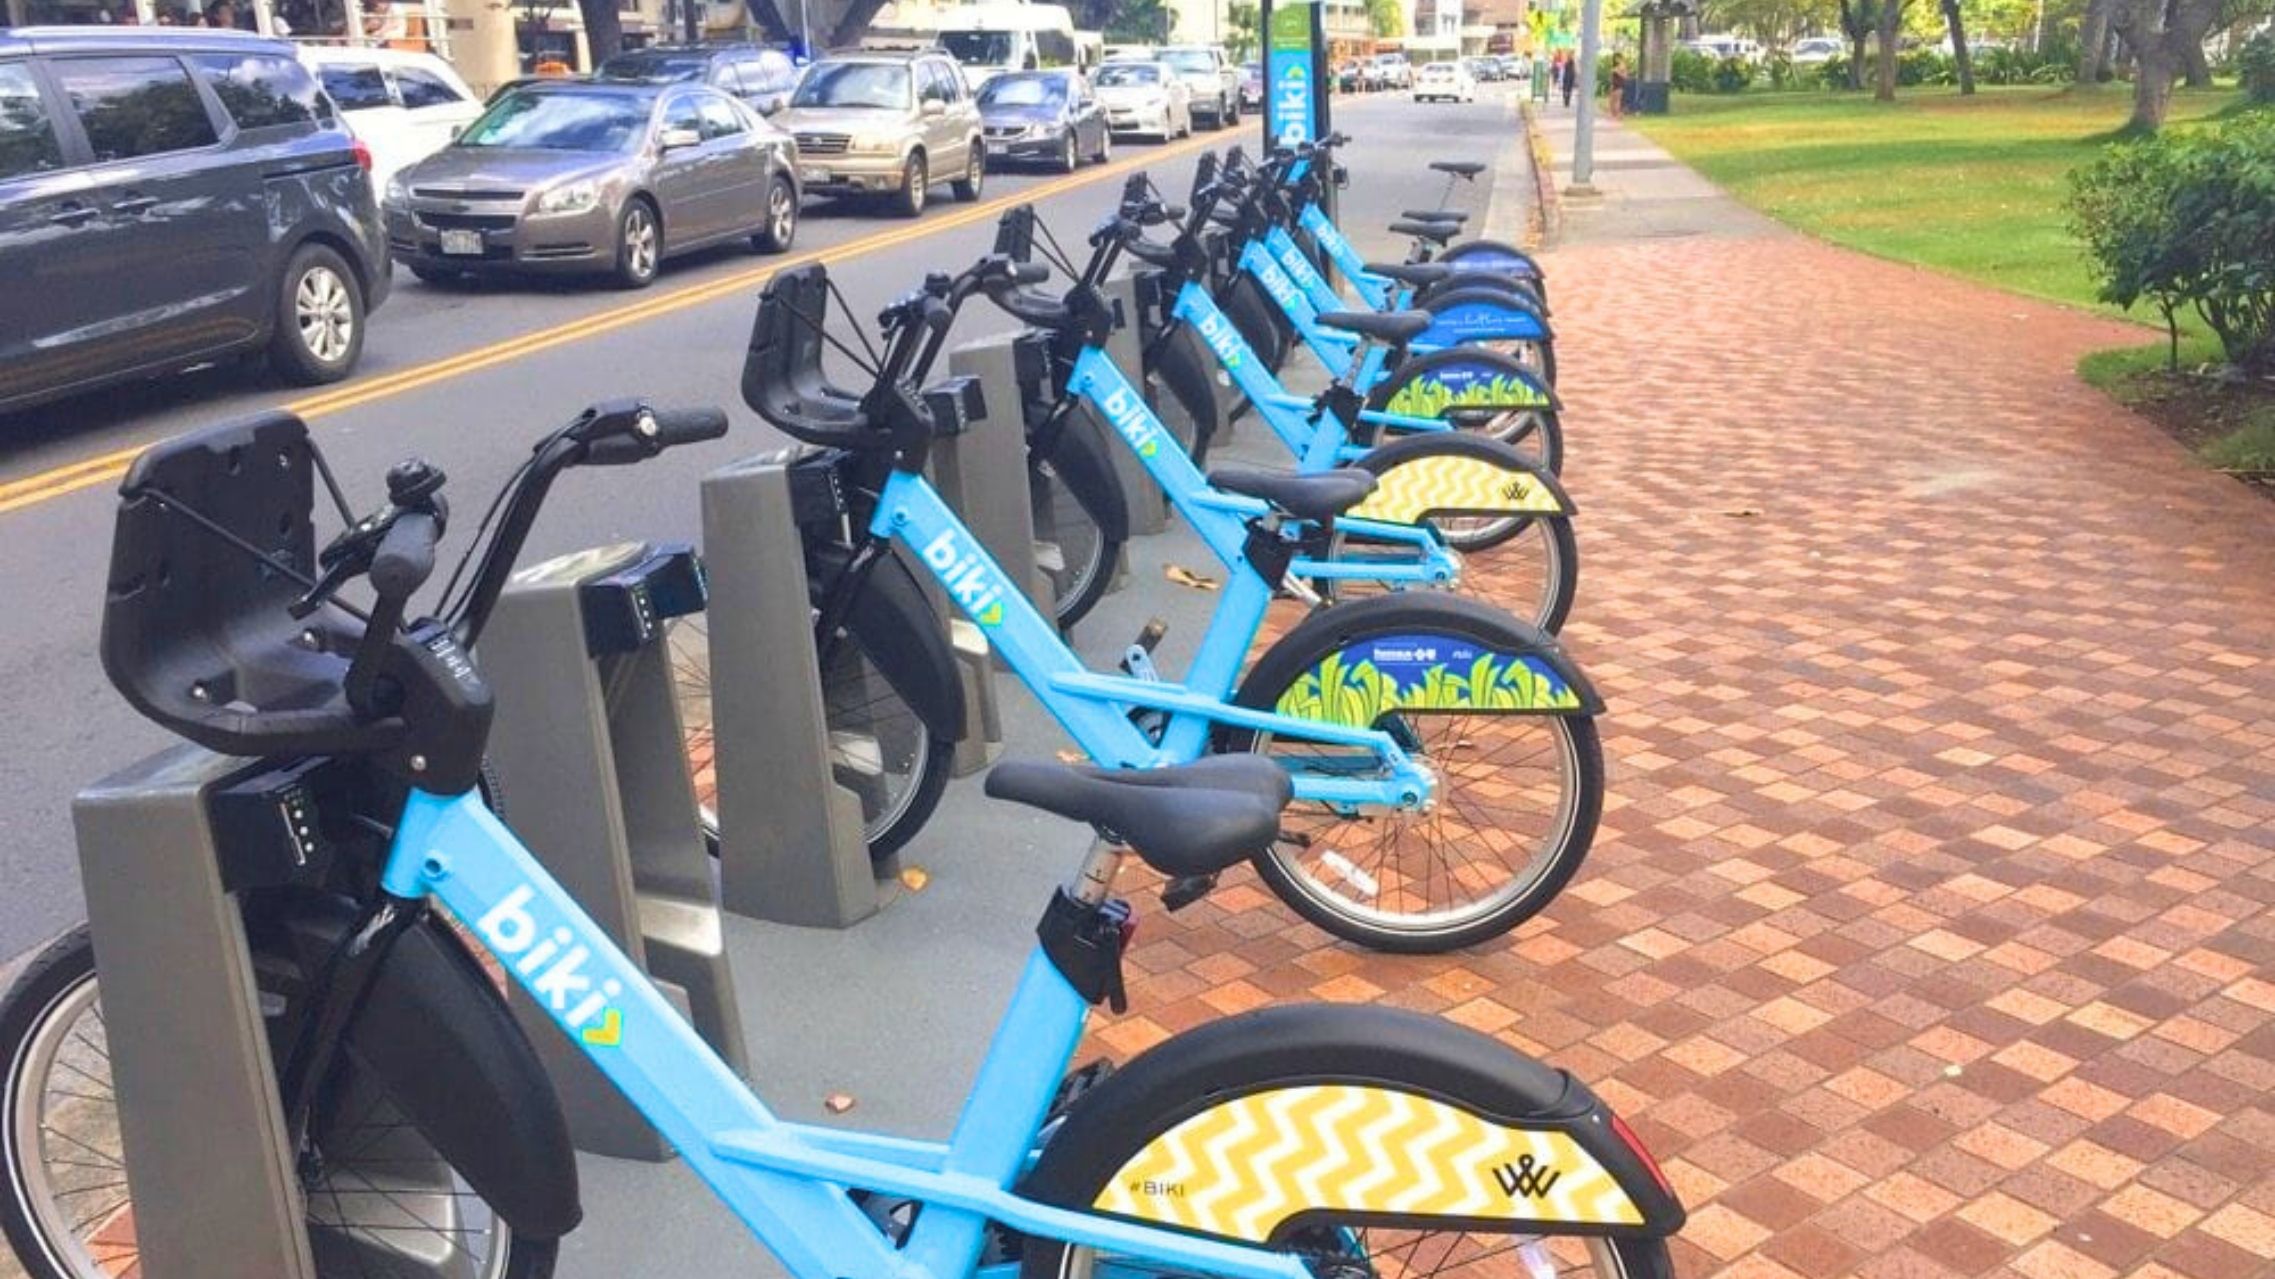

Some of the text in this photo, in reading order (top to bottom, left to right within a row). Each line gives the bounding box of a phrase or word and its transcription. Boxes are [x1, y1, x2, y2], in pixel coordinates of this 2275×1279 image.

[1278, 80, 1306, 146] biki
[1200, 312, 1243, 360] biki
[1104, 386, 1159, 448] biki
[923, 529, 1003, 613] biki
[477, 884, 622, 1028] biki
